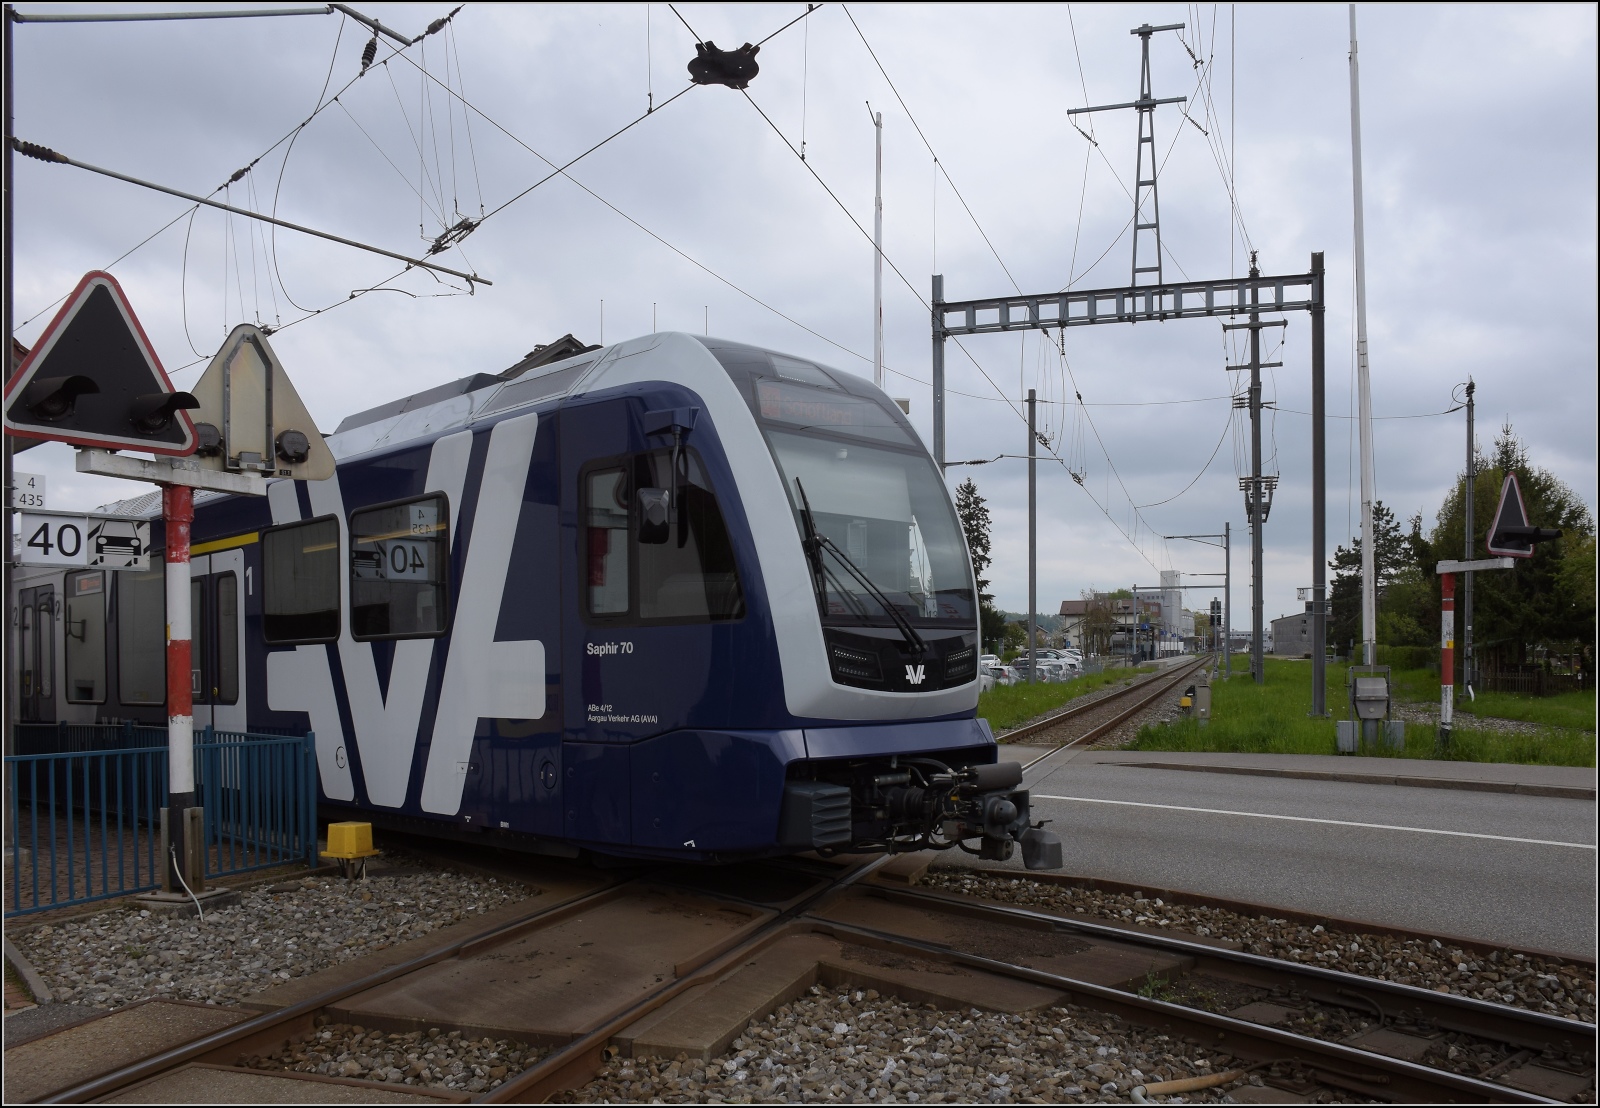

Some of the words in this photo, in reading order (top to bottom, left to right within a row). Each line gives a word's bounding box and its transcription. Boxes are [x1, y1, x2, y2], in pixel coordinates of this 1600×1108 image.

[27, 477, 36, 489] 4
[19, 493, 43, 507] 435
[27, 522, 82, 557] 40
[246, 566, 253, 596] 1
[55, 600, 61, 621] 2
[587, 642, 618, 657] Saphir
[620, 642, 633, 653] 70
[588, 704, 599, 712] ABe
[600, 704, 612, 712] 4/12
[588, 714, 607, 723] Aargau
[641, 715, 658, 724] (AVA)
